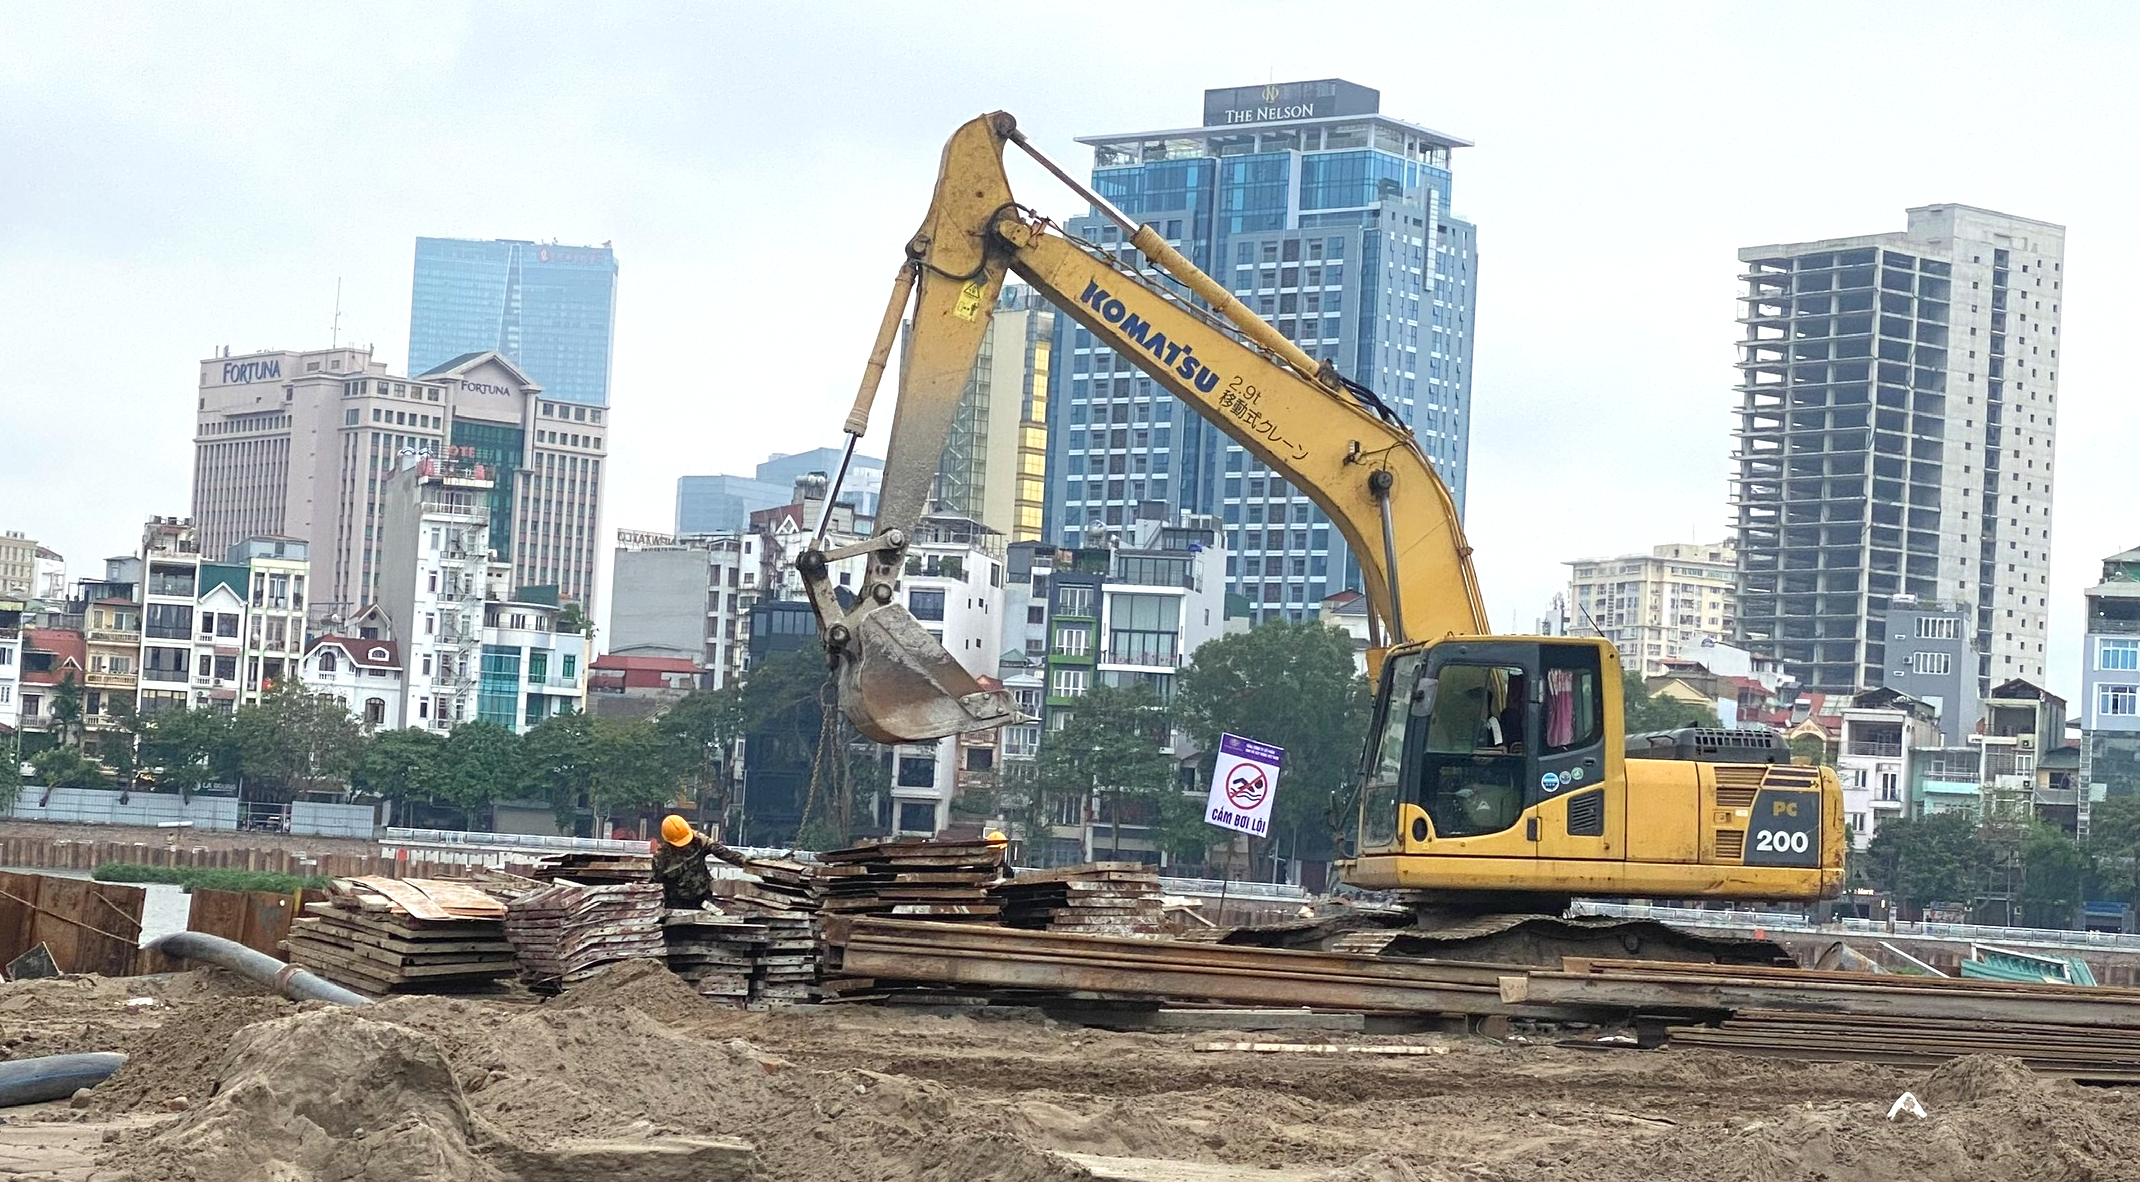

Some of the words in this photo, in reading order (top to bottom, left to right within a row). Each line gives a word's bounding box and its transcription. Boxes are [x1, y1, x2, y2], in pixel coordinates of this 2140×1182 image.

[1225, 109, 1253, 124] THE
[1256, 103, 1314, 121] NELSON
[1079, 280, 1220, 393] KOMATSU
[222, 359, 281, 385] FORTUNA
[461, 380, 511, 397] FORTUNA
[1228, 374, 1262, 406] 2.9t
[1218, 388, 1309, 460] 移動式クレーン
[1211, 805, 1233, 825] CẤM
[1233, 813, 1251, 830] BƠI
[1251, 817, 1267, 836] LỘI
[1772, 800, 1798, 818] PC
[1755, 829, 1809, 854] 200
